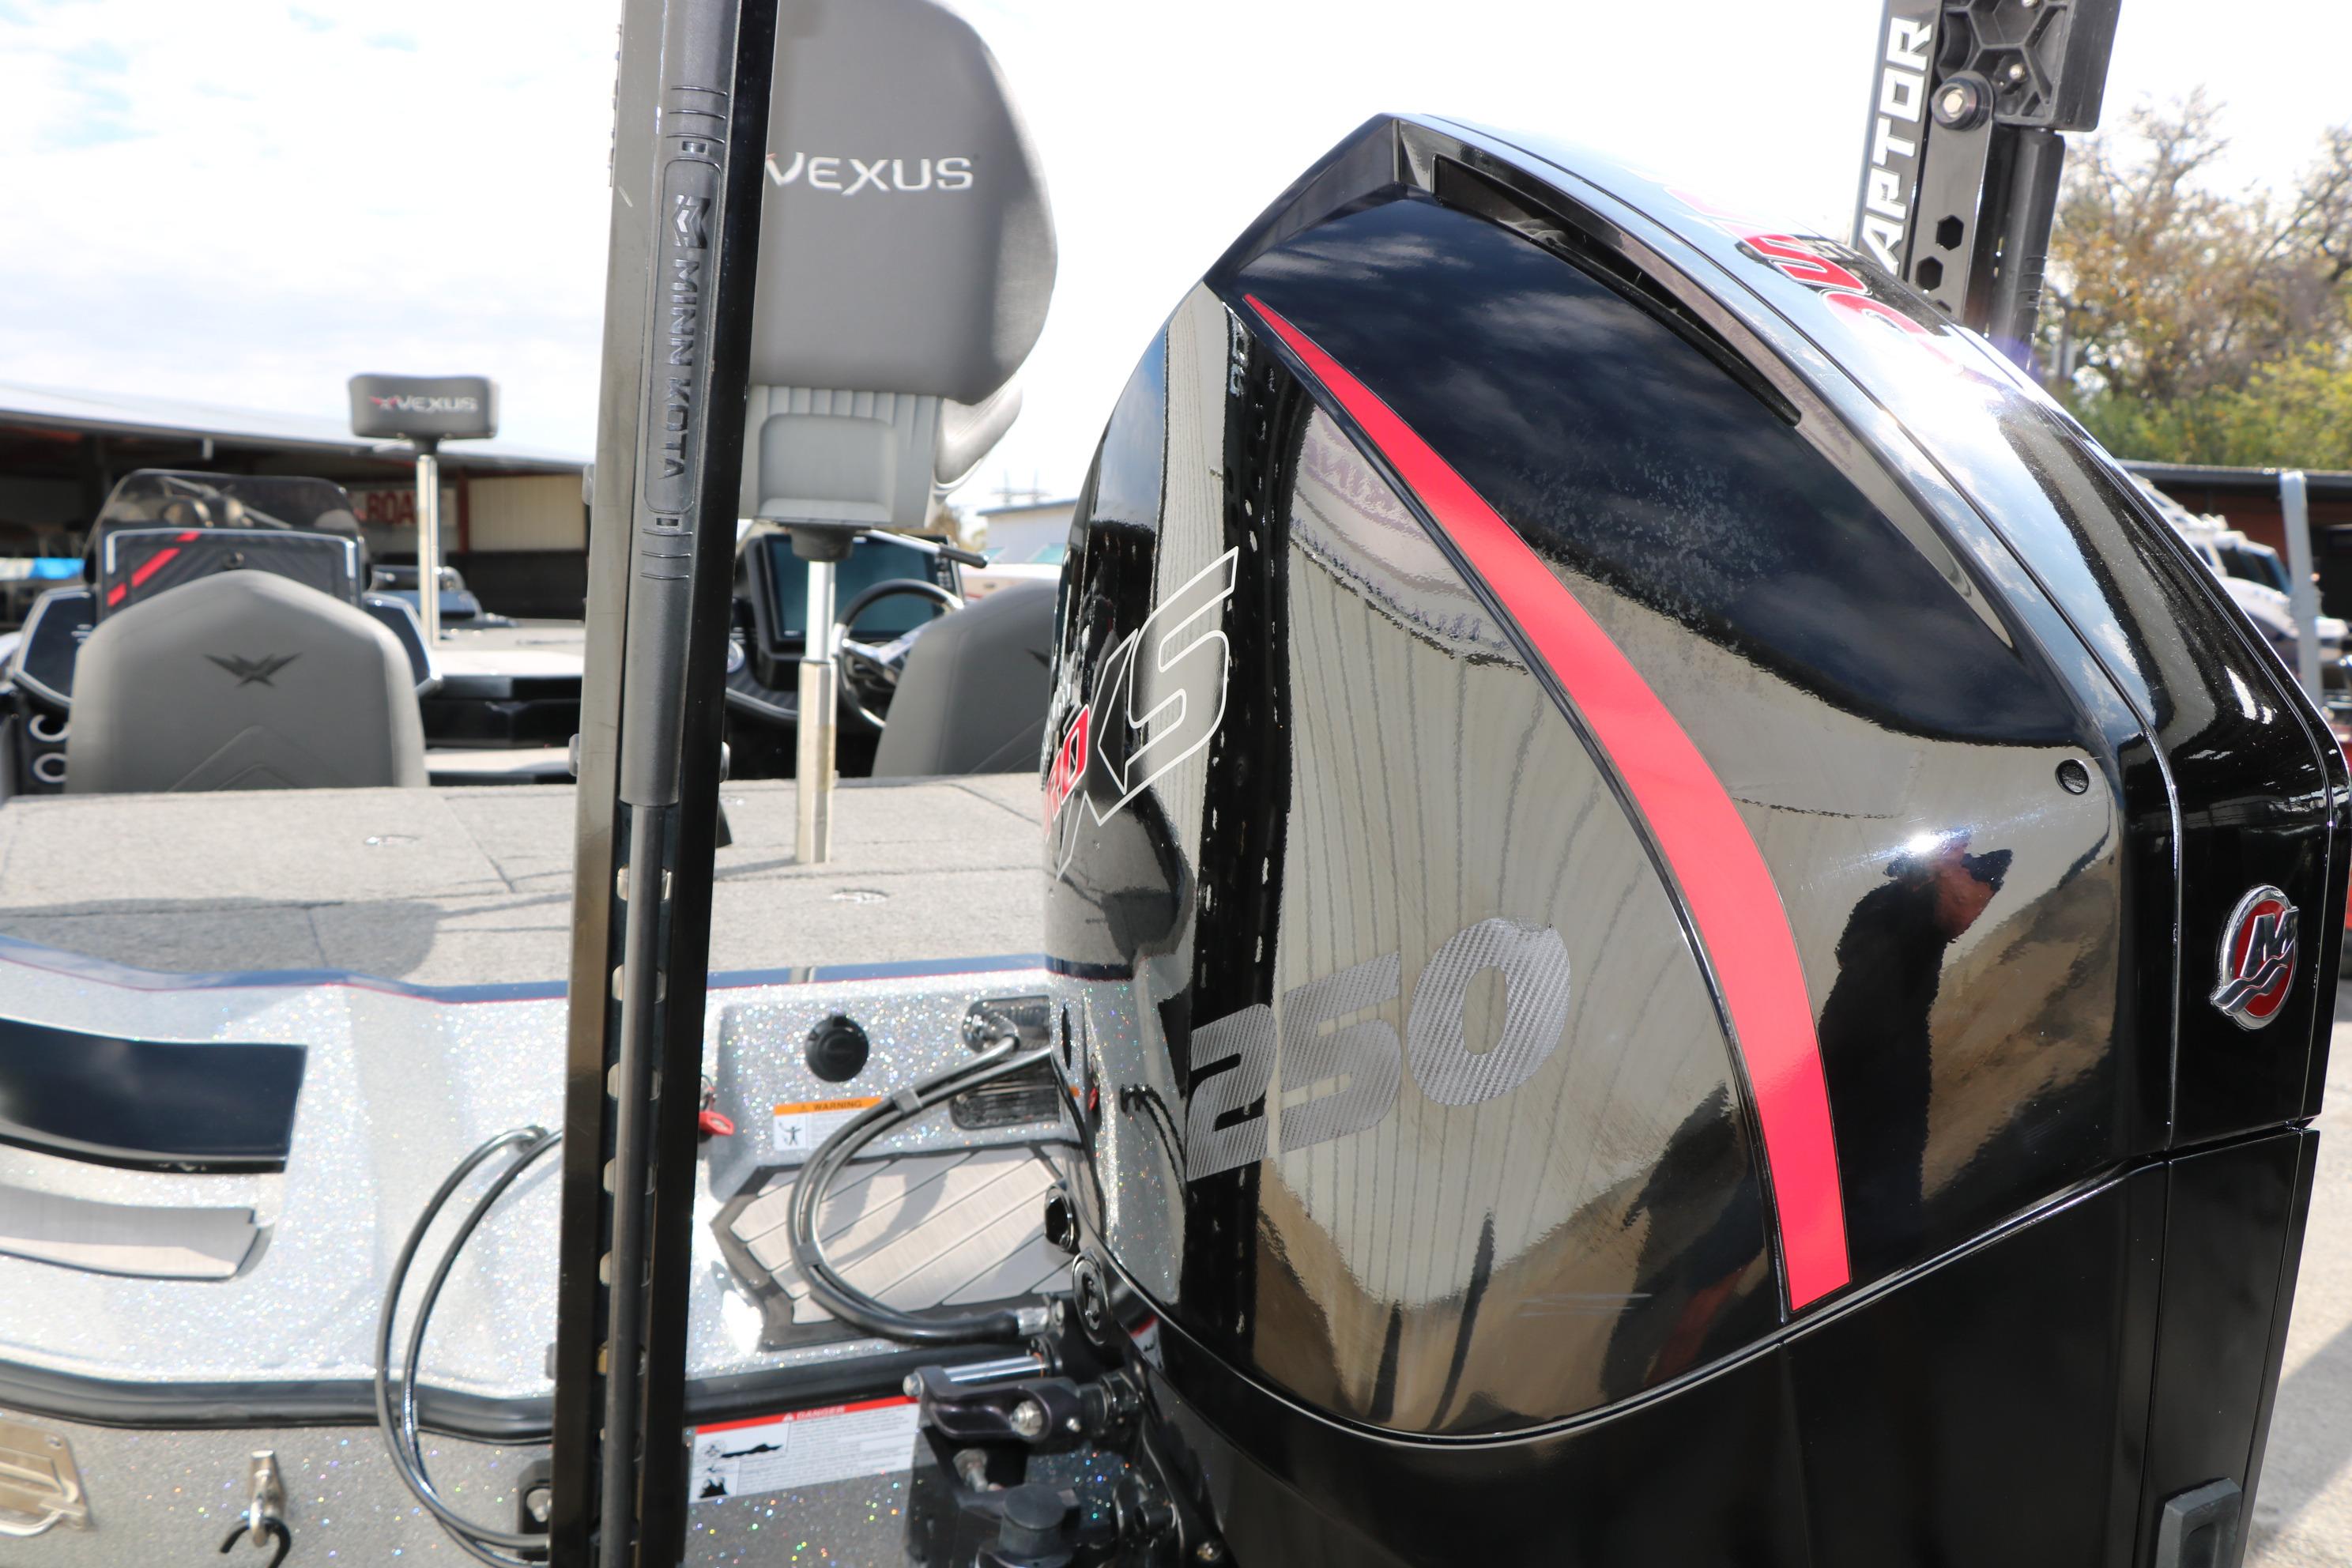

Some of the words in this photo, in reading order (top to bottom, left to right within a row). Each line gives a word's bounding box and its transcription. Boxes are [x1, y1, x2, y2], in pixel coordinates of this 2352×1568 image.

[765, 151, 974, 196] VEXUS
[1862, 17, 1933, 277] APTOR
[665, 258, 699, 367] MINN
[398, 394, 479, 413] VEXUS
[658, 377, 692, 480] KOTA
[1186, 918, 1571, 1182] 250
[813, 1100, 862, 1111] WARNING
[796, 1406, 846, 1420] DANGER
